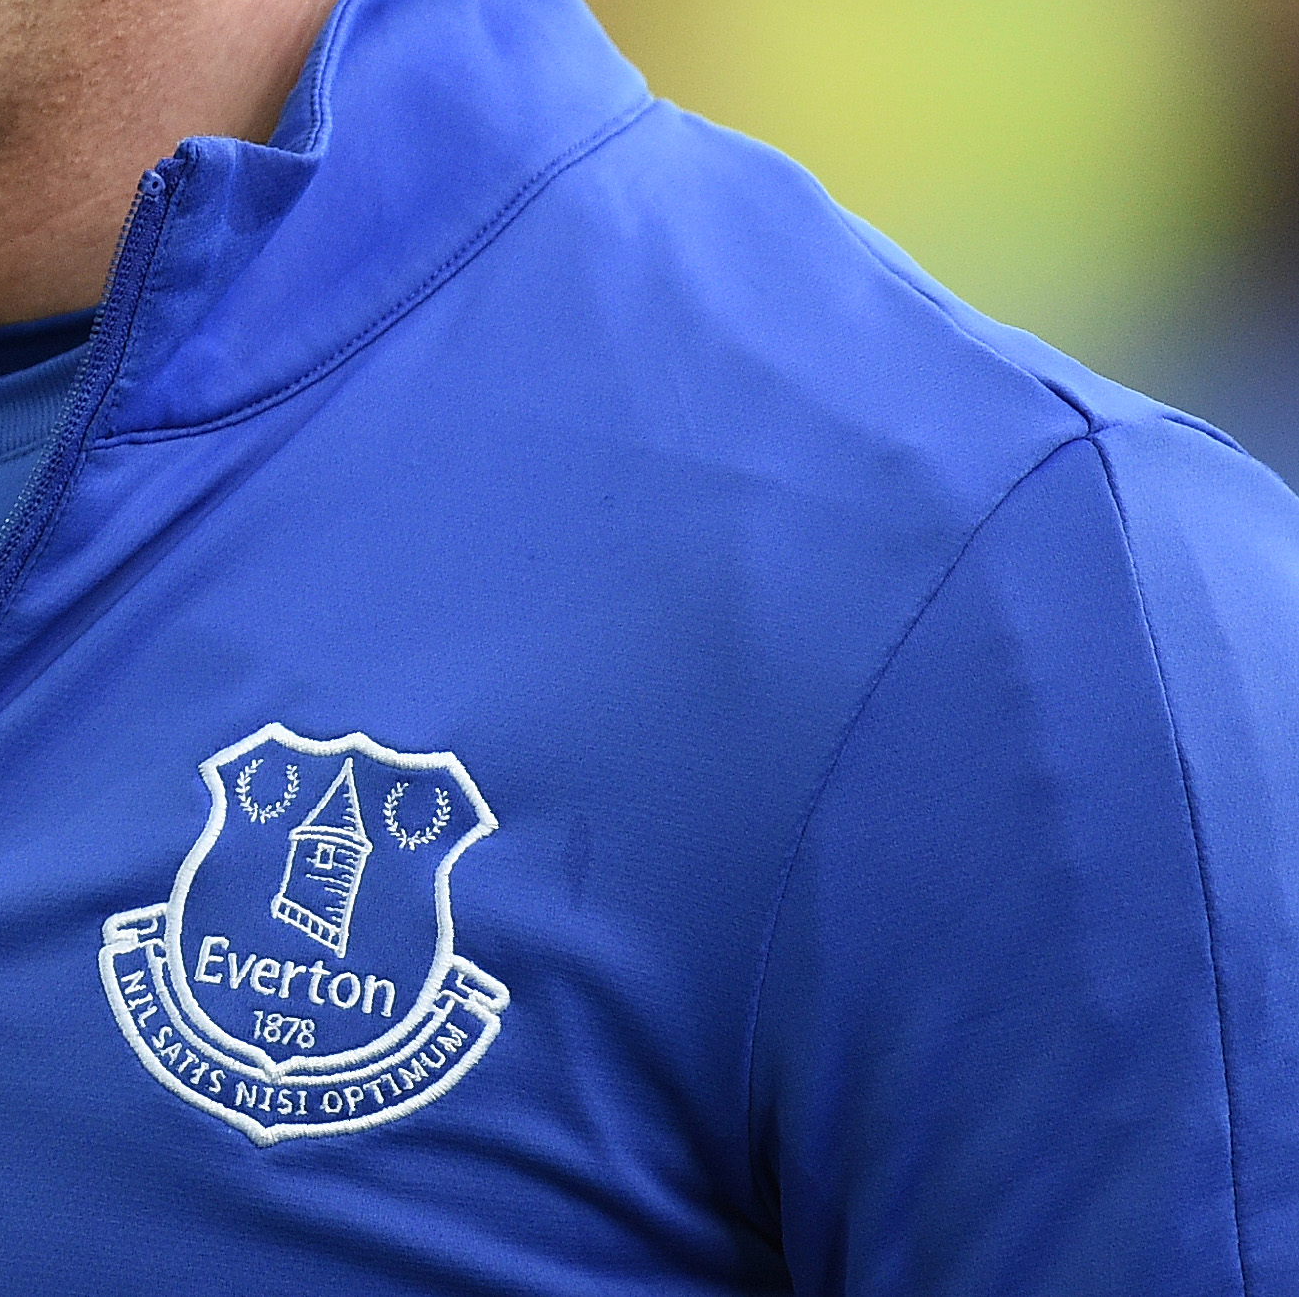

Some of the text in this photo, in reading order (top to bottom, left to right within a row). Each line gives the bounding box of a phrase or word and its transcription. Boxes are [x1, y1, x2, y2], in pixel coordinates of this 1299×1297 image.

[195, 936, 396, 1016] Everton
[121, 970, 468, 1115] NIL SATIS NISI OPTIMUM
[254, 1011, 316, 1048] 1878
